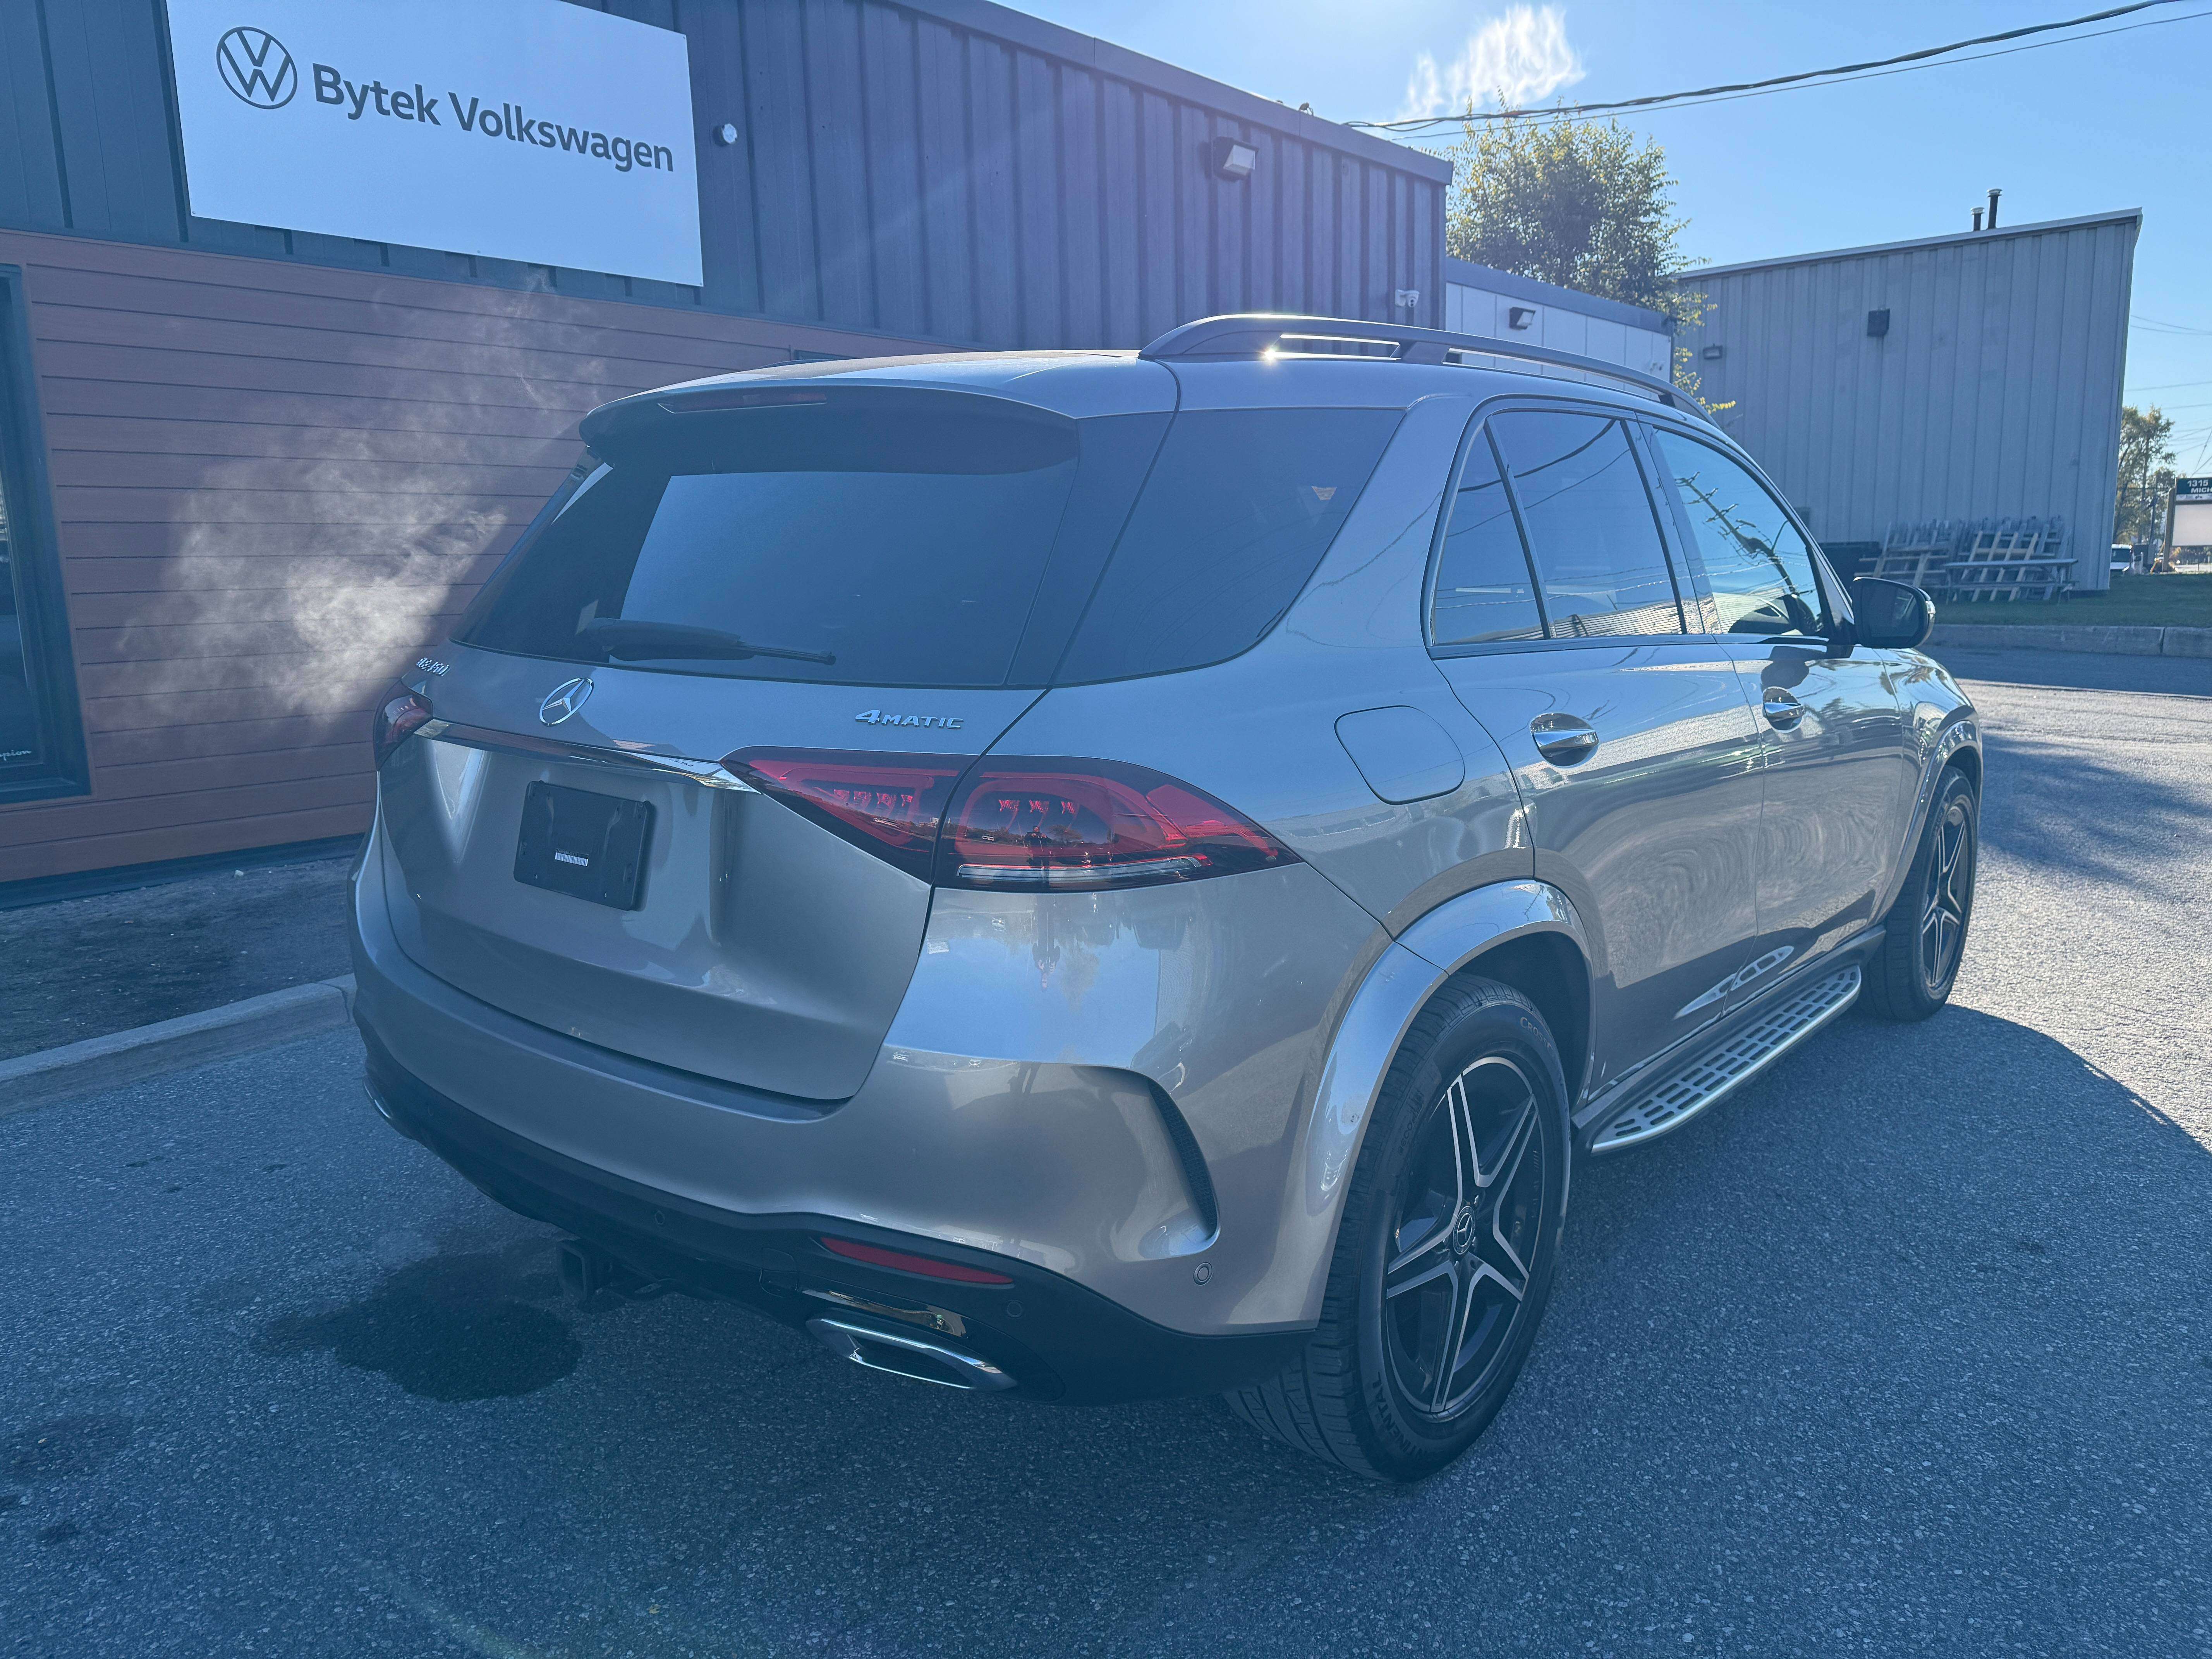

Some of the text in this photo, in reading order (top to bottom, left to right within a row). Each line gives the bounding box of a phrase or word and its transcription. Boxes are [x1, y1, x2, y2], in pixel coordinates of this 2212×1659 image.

[312, 63, 673, 172] Bytek Volkswagen
[855, 709, 964, 729] 4MATIC
